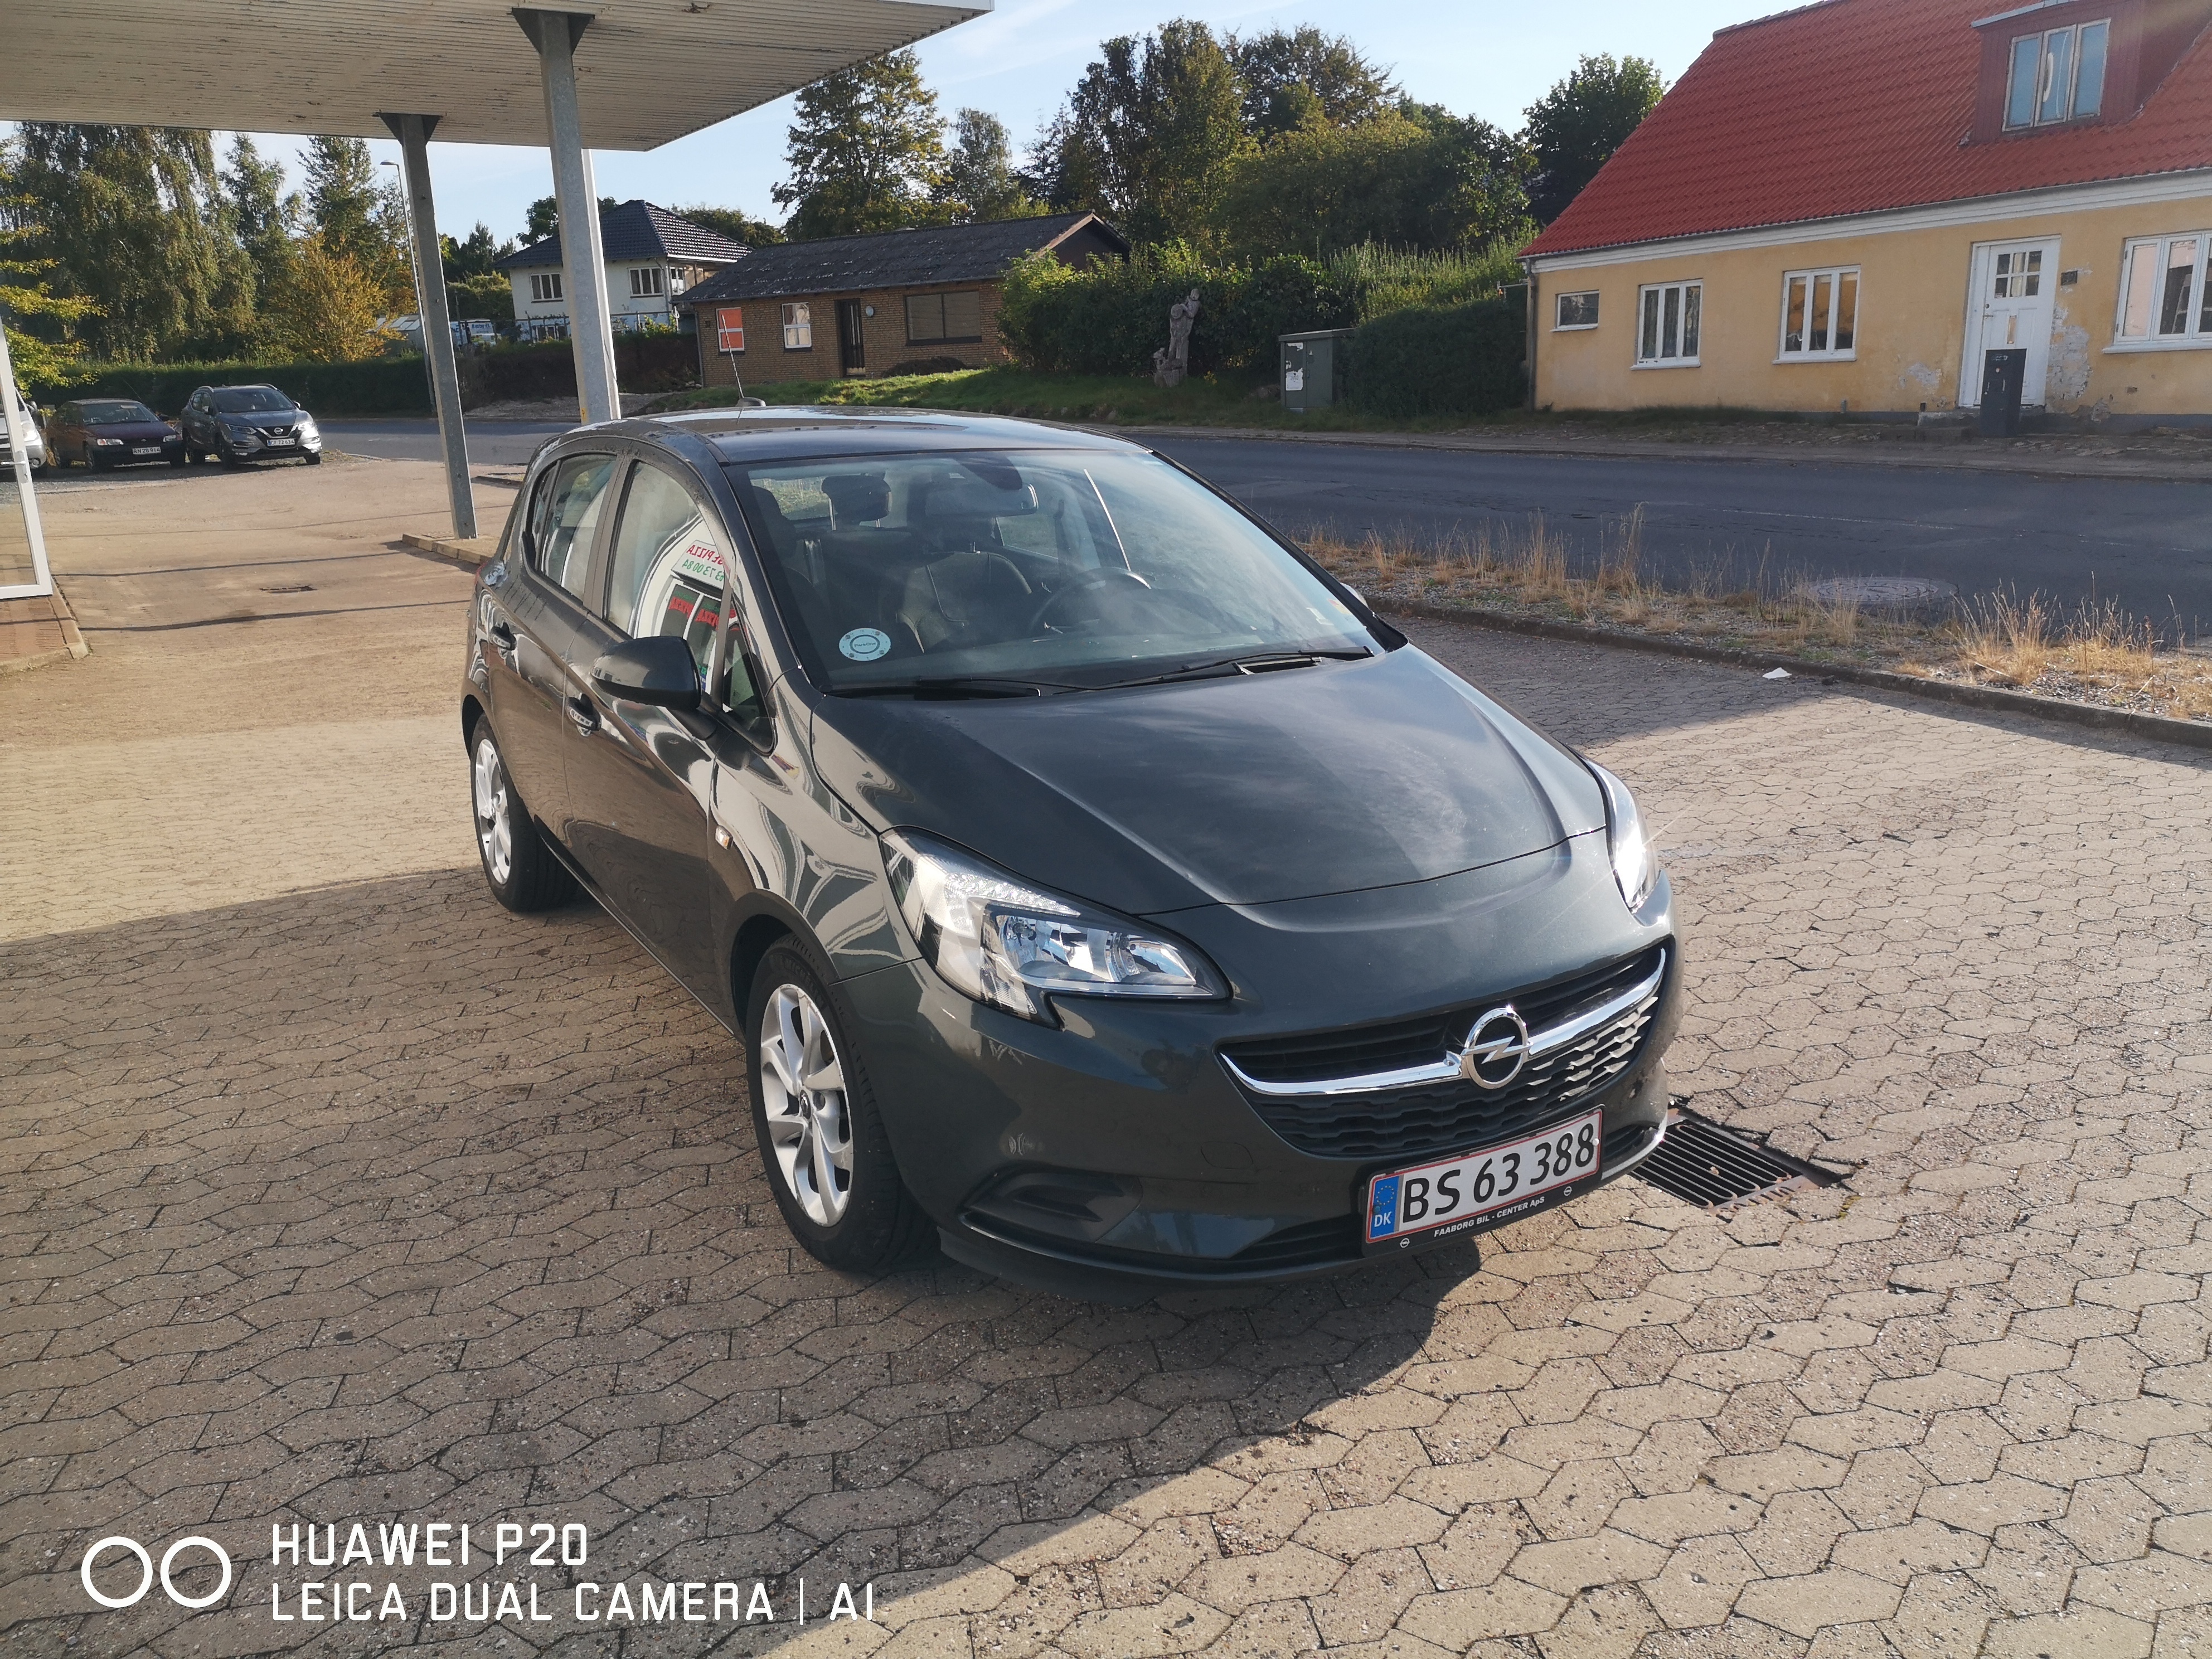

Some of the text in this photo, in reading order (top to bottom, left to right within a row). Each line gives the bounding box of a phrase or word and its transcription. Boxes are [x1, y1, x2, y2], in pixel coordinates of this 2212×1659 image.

[1374, 1123, 1594, 1228] DK BS 63 388
[1434, 1219, 1474, 1238] FAABORG
[1477, 1215, 1490, 1225] BIL
[1497, 1204, 1529, 1220] CENTER
[1530, 1196, 1545, 1209] ApS
